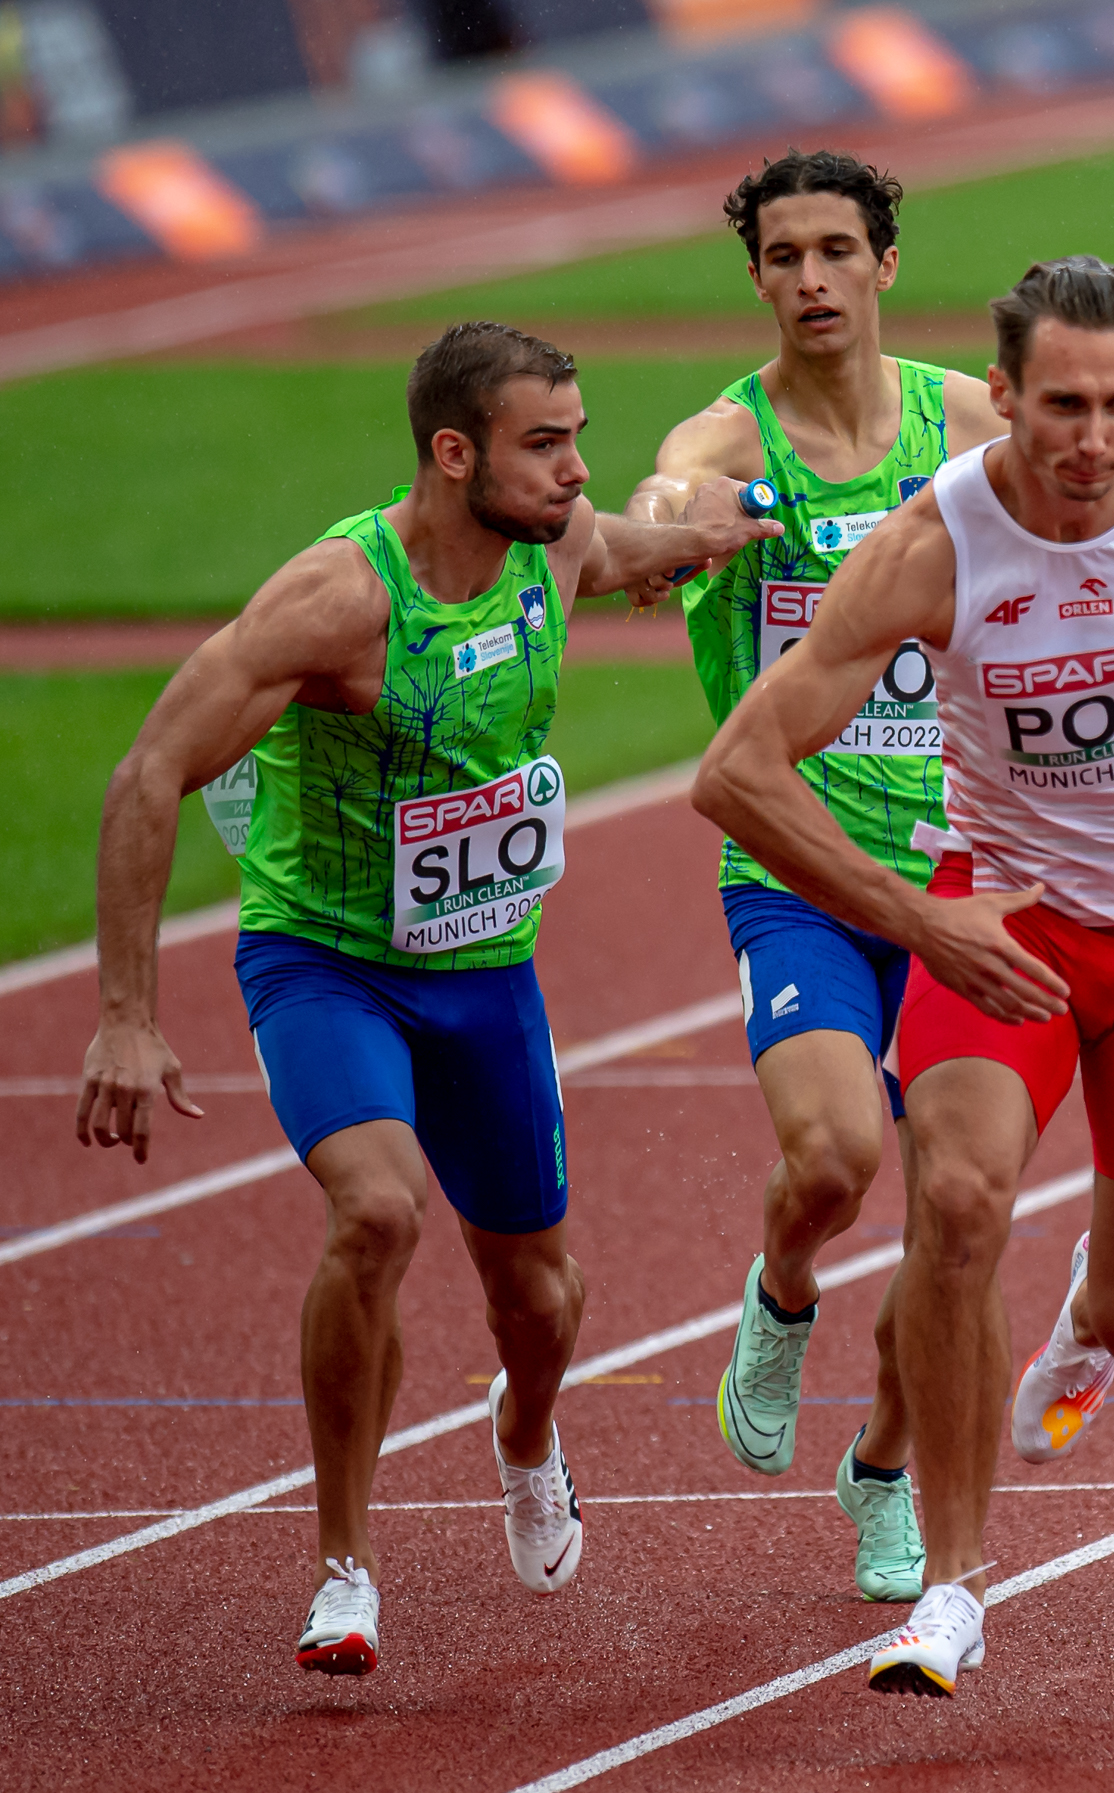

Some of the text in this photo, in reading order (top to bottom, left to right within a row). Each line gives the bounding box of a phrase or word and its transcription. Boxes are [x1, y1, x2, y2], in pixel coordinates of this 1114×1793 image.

[845, 520, 880, 532] Teleko
[984, 593, 1036, 626] 4F
[1060, 601, 1111, 617] ORLEN
[477, 633, 513, 652] Telekom
[882, 725, 941, 747] 2022
[1049, 752, 1087, 767] RUN
[1009, 763, 1114, 788] MUNICH
[403, 781, 521, 839] SPAR
[410, 817, 547, 905] SLO
[444, 892, 474, 913] RUN
[405, 907, 497, 948] MUNICH
